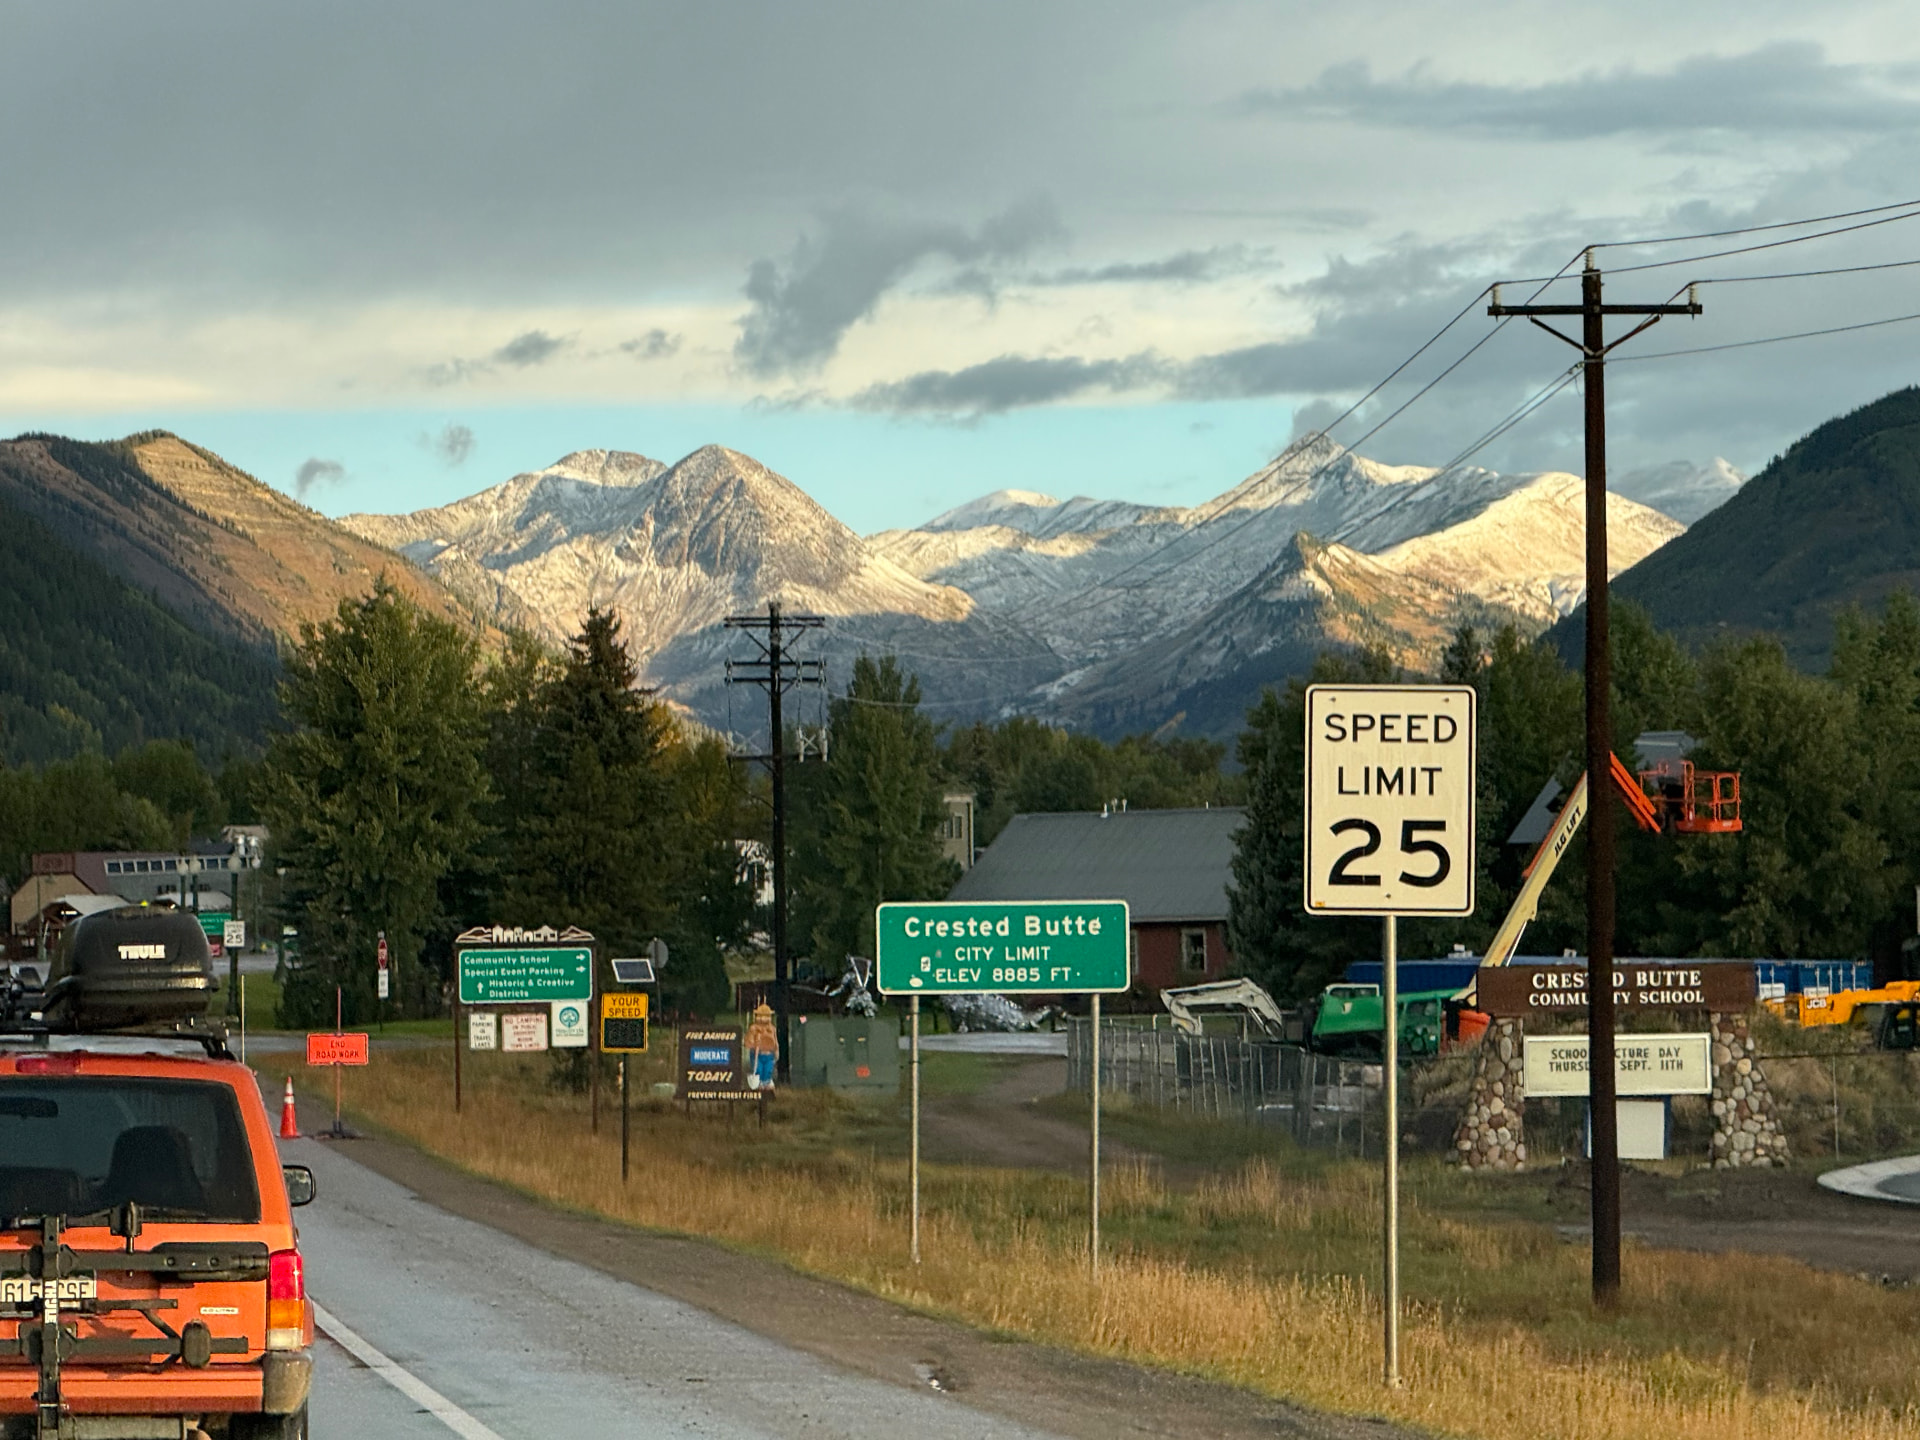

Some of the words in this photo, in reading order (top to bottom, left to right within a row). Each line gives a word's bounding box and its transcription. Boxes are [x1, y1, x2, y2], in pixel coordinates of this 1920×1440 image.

[1325, 713, 1458, 743] SPEED
[1338, 766, 1442, 796] LIMIT
[1554, 832, 1567, 858] JLG
[1567, 805, 1581, 834] LIFT
[1328, 818, 1451, 888] 25
[904, 916, 1010, 937] Crested
[1025, 915, 1102, 936] Butte
[226, 934, 243, 944] 25
[118, 945, 166, 960] THULE
[954, 946, 994, 961] CITY
[1005, 946, 1051, 961] LIMIT
[464, 956, 517, 966] Community
[520, 955, 550, 964] School
[464, 968, 498, 978] Special
[501, 967, 527, 976] Event
[529, 966, 565, 976] Parking
[935, 967, 981, 983] ELEV
[992, 967, 1041, 982] 8885
[489, 979, 525, 988] Historic
[528, 978, 535, 987] &
[537, 978, 575, 987] Creative
[1532, 971, 1624, 989] CRESD
[1636, 970, 1702, 988] BUTTE
[489, 989, 530, 998] Districts
[1529, 991, 1631, 1006] COMMUTY
[1639, 989, 1705, 1004] SCHOOL
[611, 997, 640, 1006] YOUR
[1806, 999, 1827, 1009] JCB
[608, 1008, 641, 1017] SPEED
[685, 1031, 704, 1040] FIRE
[704, 1031, 737, 1040] DANGER
[330, 1040, 346, 1048] END
[315, 1050, 337, 1059] ROAD
[339, 1050, 359, 1058] WORK
[694, 1050, 729, 1061] MODERATE
[1551, 1048, 1589, 1060] SCHOO
[1614, 1048, 1650, 1059] CTURE
[1658, 1046, 1681, 1058] DAY
[1620, 1059, 1652, 1071] SEPT.
[687, 1071, 733, 1082] TODAY!
[687, 1091, 717, 1099] PREVENT
[719, 1091, 741, 1099] FOREST
[743, 1091, 762, 1099] FIRES
